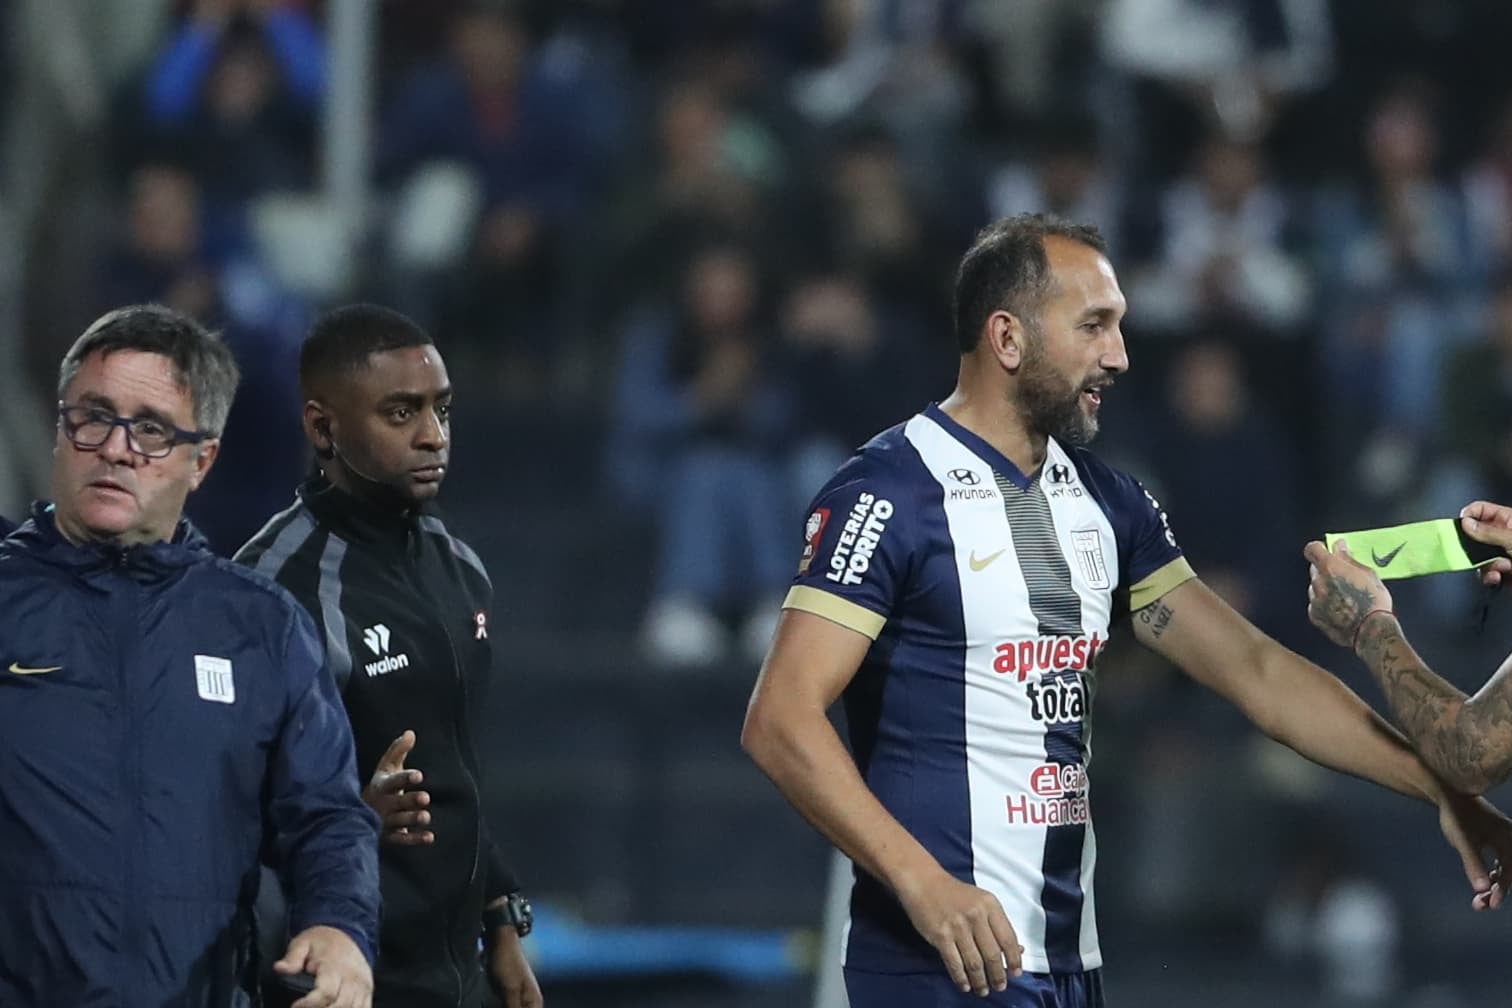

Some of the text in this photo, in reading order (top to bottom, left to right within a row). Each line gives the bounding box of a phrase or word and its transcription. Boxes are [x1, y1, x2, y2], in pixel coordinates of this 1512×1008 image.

[950, 488, 998, 501] HYUNDAI
[842, 499, 894, 585] TORITO
[364, 653, 409, 677] walon
[993, 631, 1107, 683] apuest
[1026, 681, 1090, 721] total
[1006, 794, 1090, 825] Huanca
